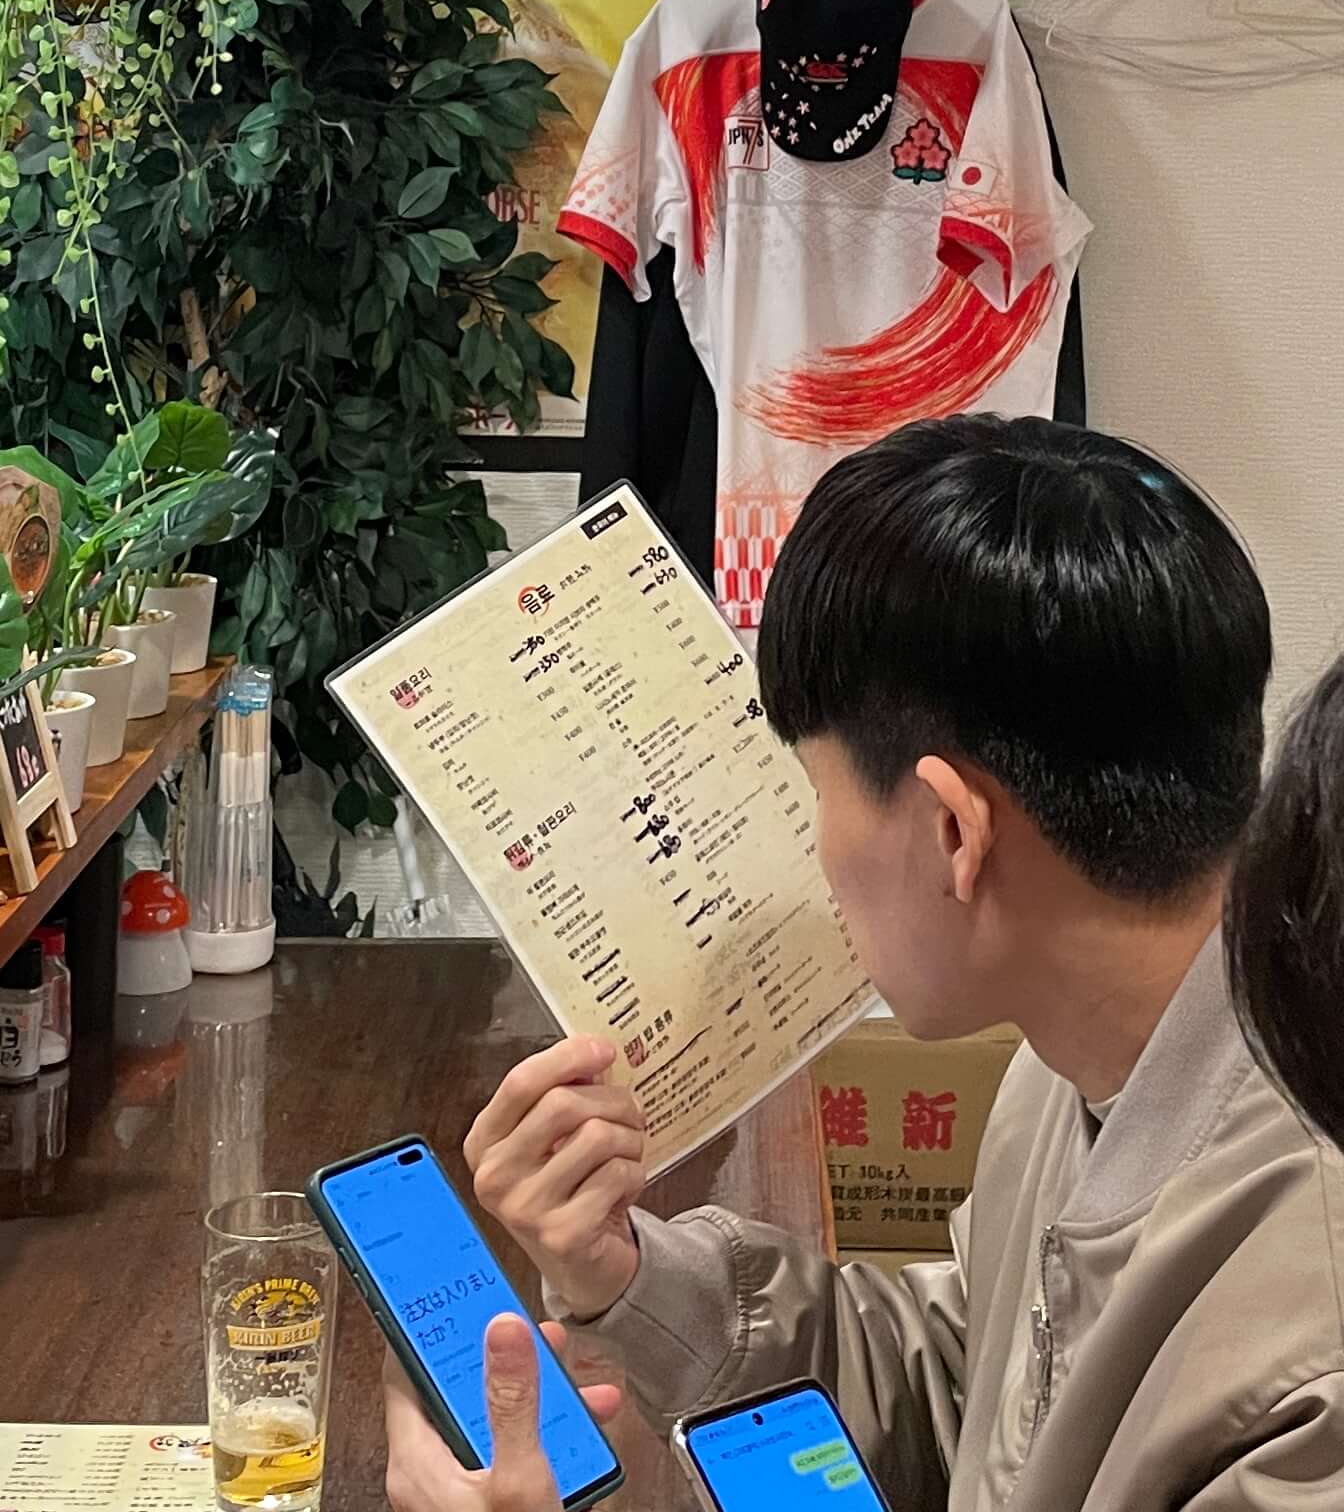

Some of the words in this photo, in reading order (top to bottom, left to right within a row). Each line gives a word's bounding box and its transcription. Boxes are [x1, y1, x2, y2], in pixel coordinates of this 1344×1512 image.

[488, 188, 541, 225] ORSE
[642, 544, 670, 570] 580
[400, 1267, 497, 1324] 注文は入りまし
